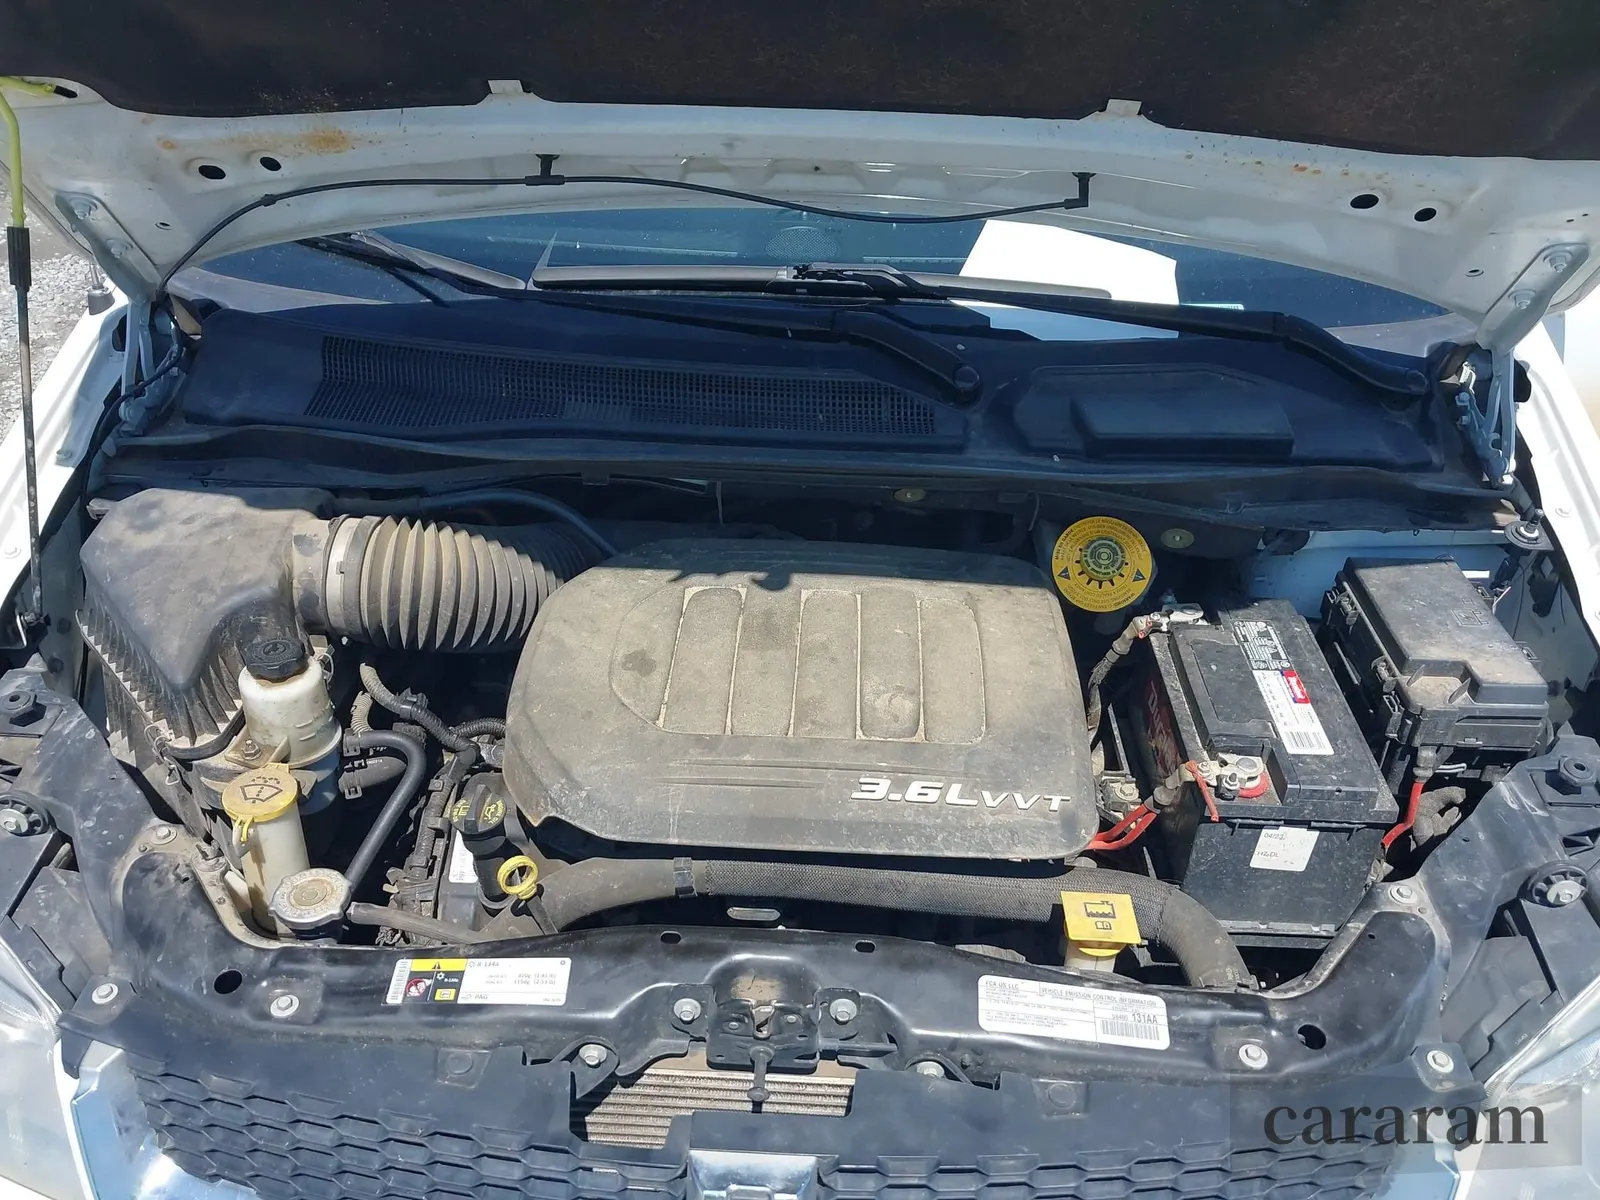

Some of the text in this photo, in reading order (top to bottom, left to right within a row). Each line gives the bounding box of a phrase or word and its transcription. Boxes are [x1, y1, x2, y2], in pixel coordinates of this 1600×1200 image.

[1041, 988, 1065, 997] VEHICLE
[1065, 990, 1092, 999] EMISSION
[1092, 993, 1118, 1003] CONTROL
[1119, 996, 1157, 1007] INFORMATION
[1131, 1012, 1158, 1024] 131AA
